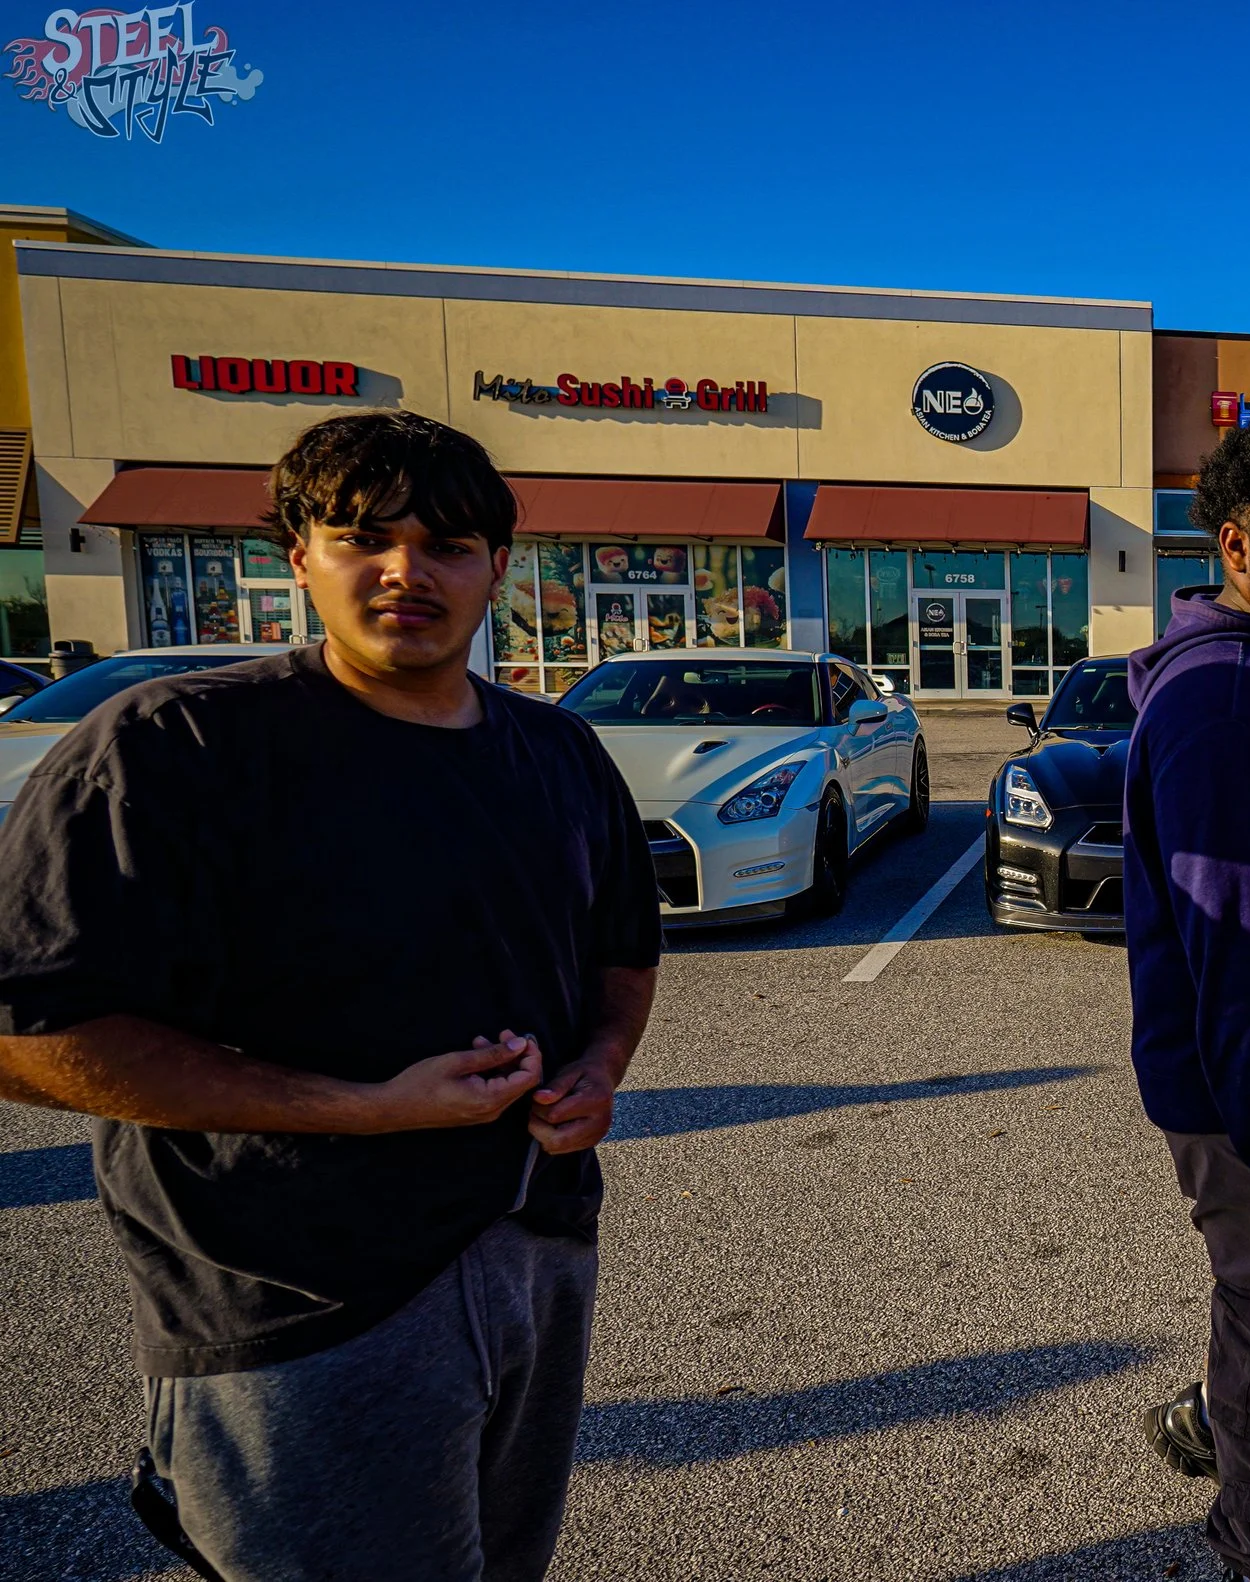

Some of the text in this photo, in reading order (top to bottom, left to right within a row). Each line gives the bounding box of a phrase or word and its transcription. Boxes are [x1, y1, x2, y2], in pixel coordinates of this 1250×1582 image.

[170, 354, 360, 397] LIQUOR
[473, 370, 768, 412] Mito Sushi Grill
[914, 406, 930, 429] ASIAN
[929, 427, 960, 441] KITCHEN
[967, 421, 986, 438] BOBA
[983, 409, 993, 423] TEA
[147, 548, 183, 557] VODKAS
[628, 570, 657, 580] 6764
[945, 574, 975, 583] 6758
